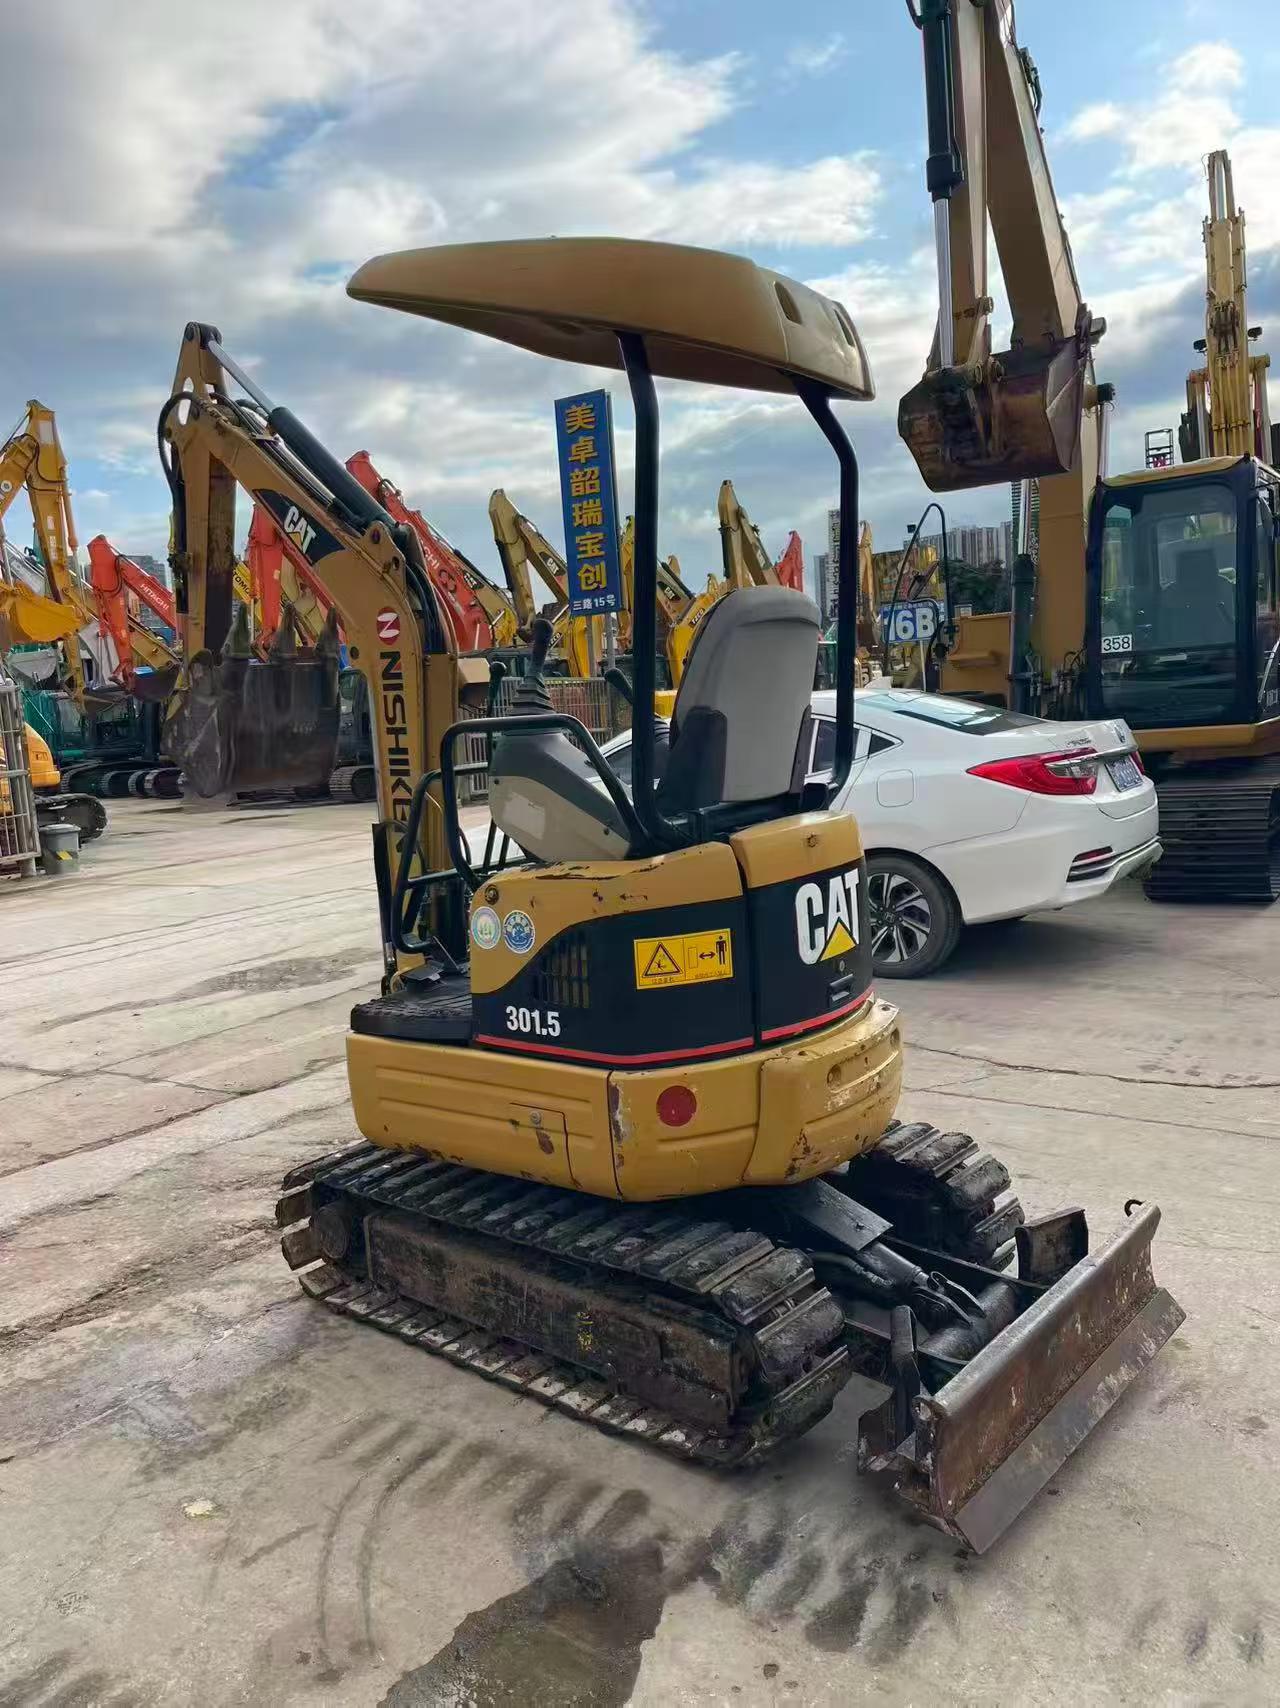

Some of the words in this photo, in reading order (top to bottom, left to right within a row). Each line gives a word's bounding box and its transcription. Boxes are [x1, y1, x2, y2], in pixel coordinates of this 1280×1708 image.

[565, 402, 608, 592] 美卓韶瑞宝创
[284, 505, 317, 554] CAT
[546, 557, 560, 575] CAT
[140, 583, 170, 610] HITACHI
[1102, 636, 1131, 652] 358
[795, 868, 860, 965] CAT
[505, 1005, 562, 1038] 301.5
